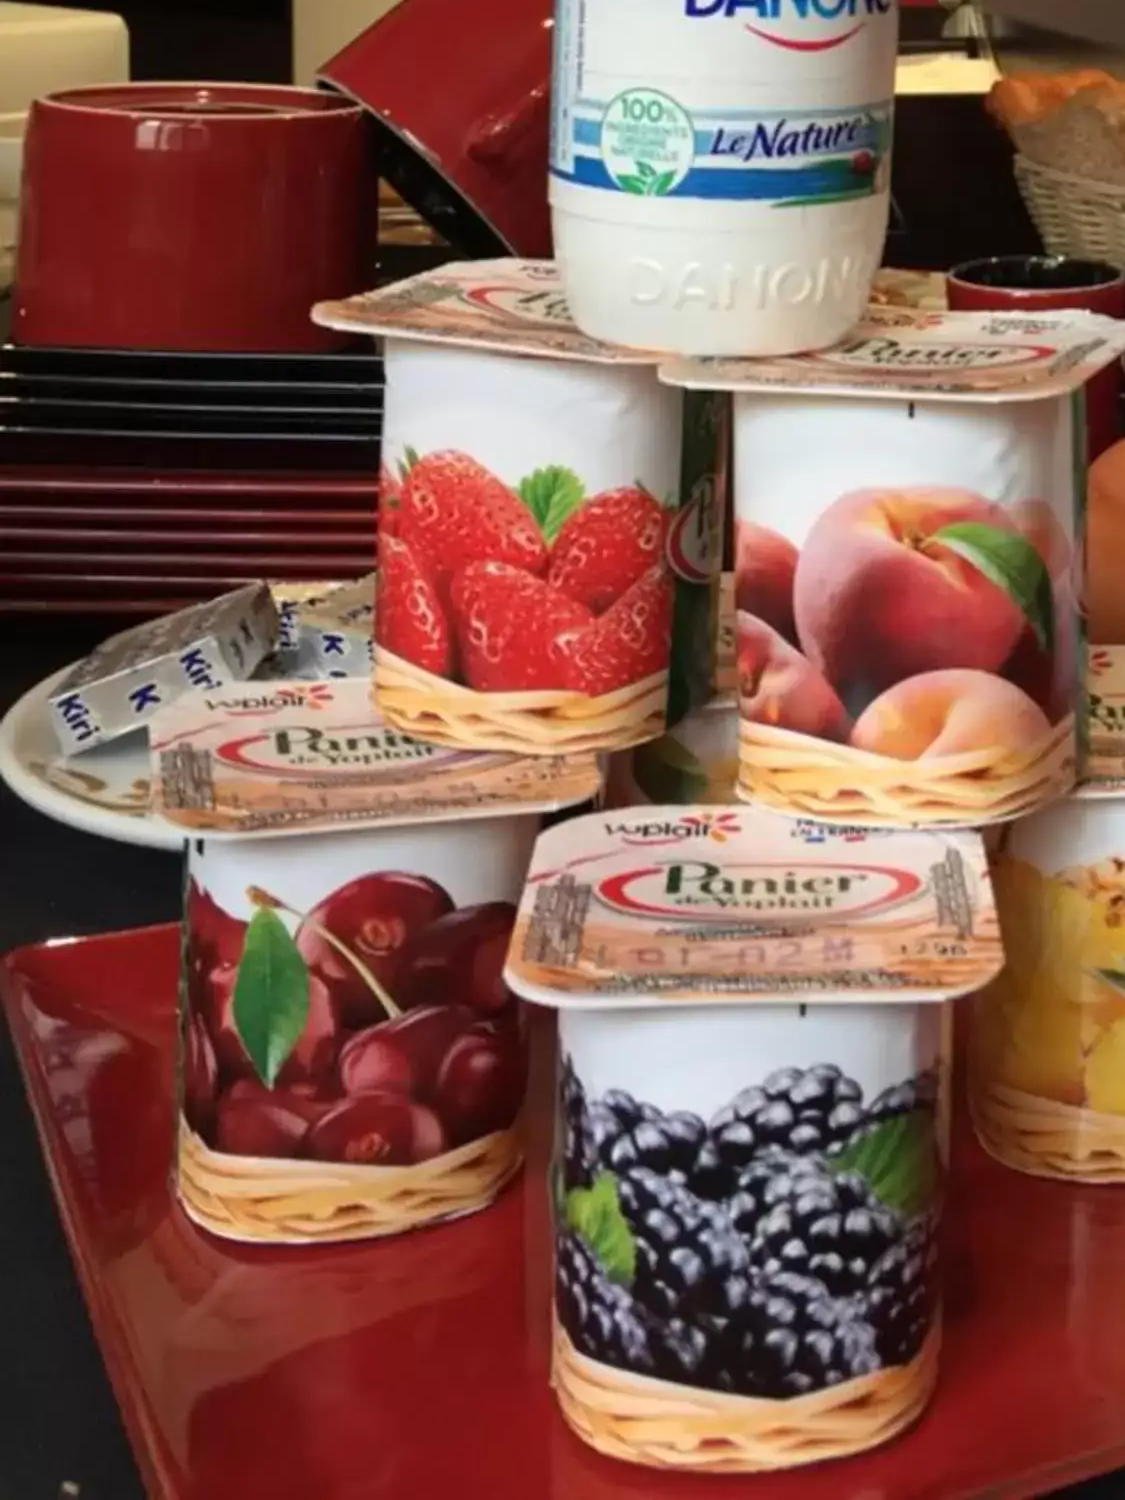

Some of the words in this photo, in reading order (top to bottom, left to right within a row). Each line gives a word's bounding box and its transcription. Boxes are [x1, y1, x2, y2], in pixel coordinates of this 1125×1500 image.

[129, 683, 162, 713] K
[57, 693, 100, 742] Kiri
[664, 860, 868, 895] Panier
